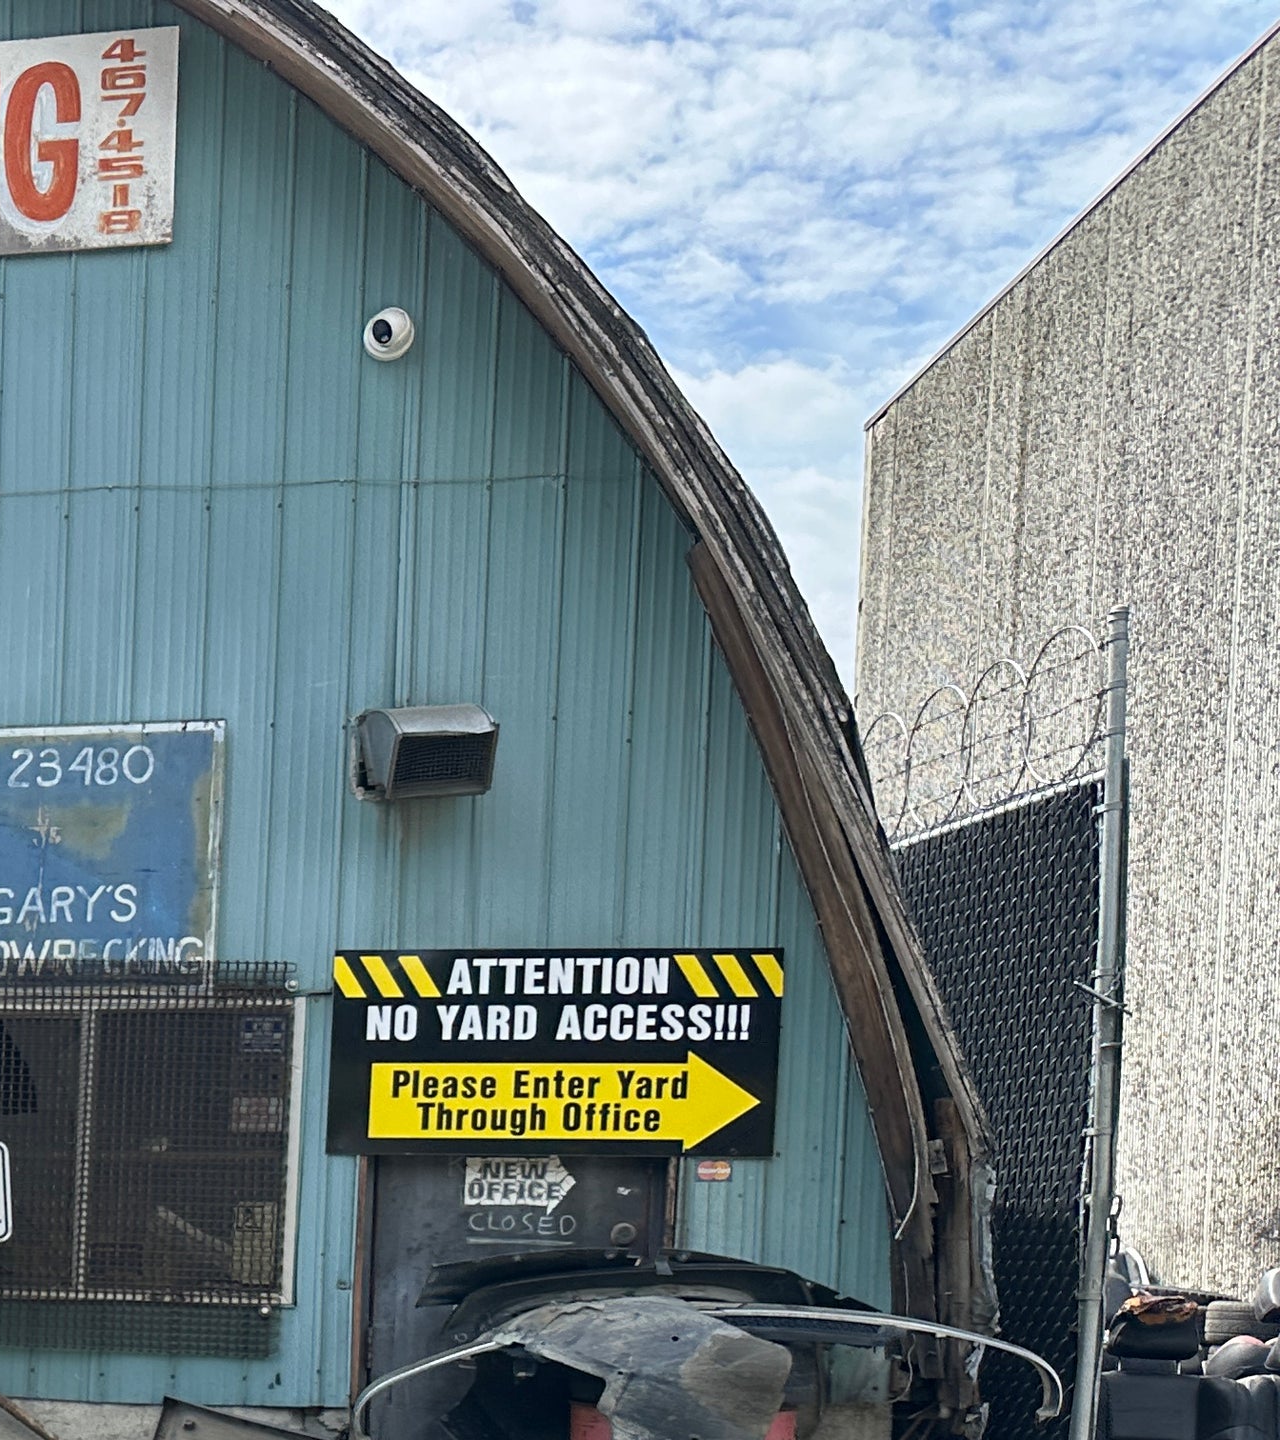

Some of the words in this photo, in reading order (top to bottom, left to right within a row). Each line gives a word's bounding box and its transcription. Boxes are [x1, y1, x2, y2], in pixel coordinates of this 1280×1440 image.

[7, 745, 155, 788] 23480
[446, 956, 671, 996] ATTENTION
[366, 1004, 418, 1042] NO
[436, 1004, 538, 1042] YARD
[555, 1003, 751, 1042] ACCESS!!!
[391, 1070, 498, 1099] Please
[513, 1070, 601, 1099] Enter
[618, 1070, 688, 1100] Yard
[417, 1102, 547, 1136] Through
[563, 1103, 661, 1132] Office
[482, 1161, 547, 1180] NEW
[468, 1178, 561, 1201] OFFICE
[468, 1212, 576, 1236] CLOSED
